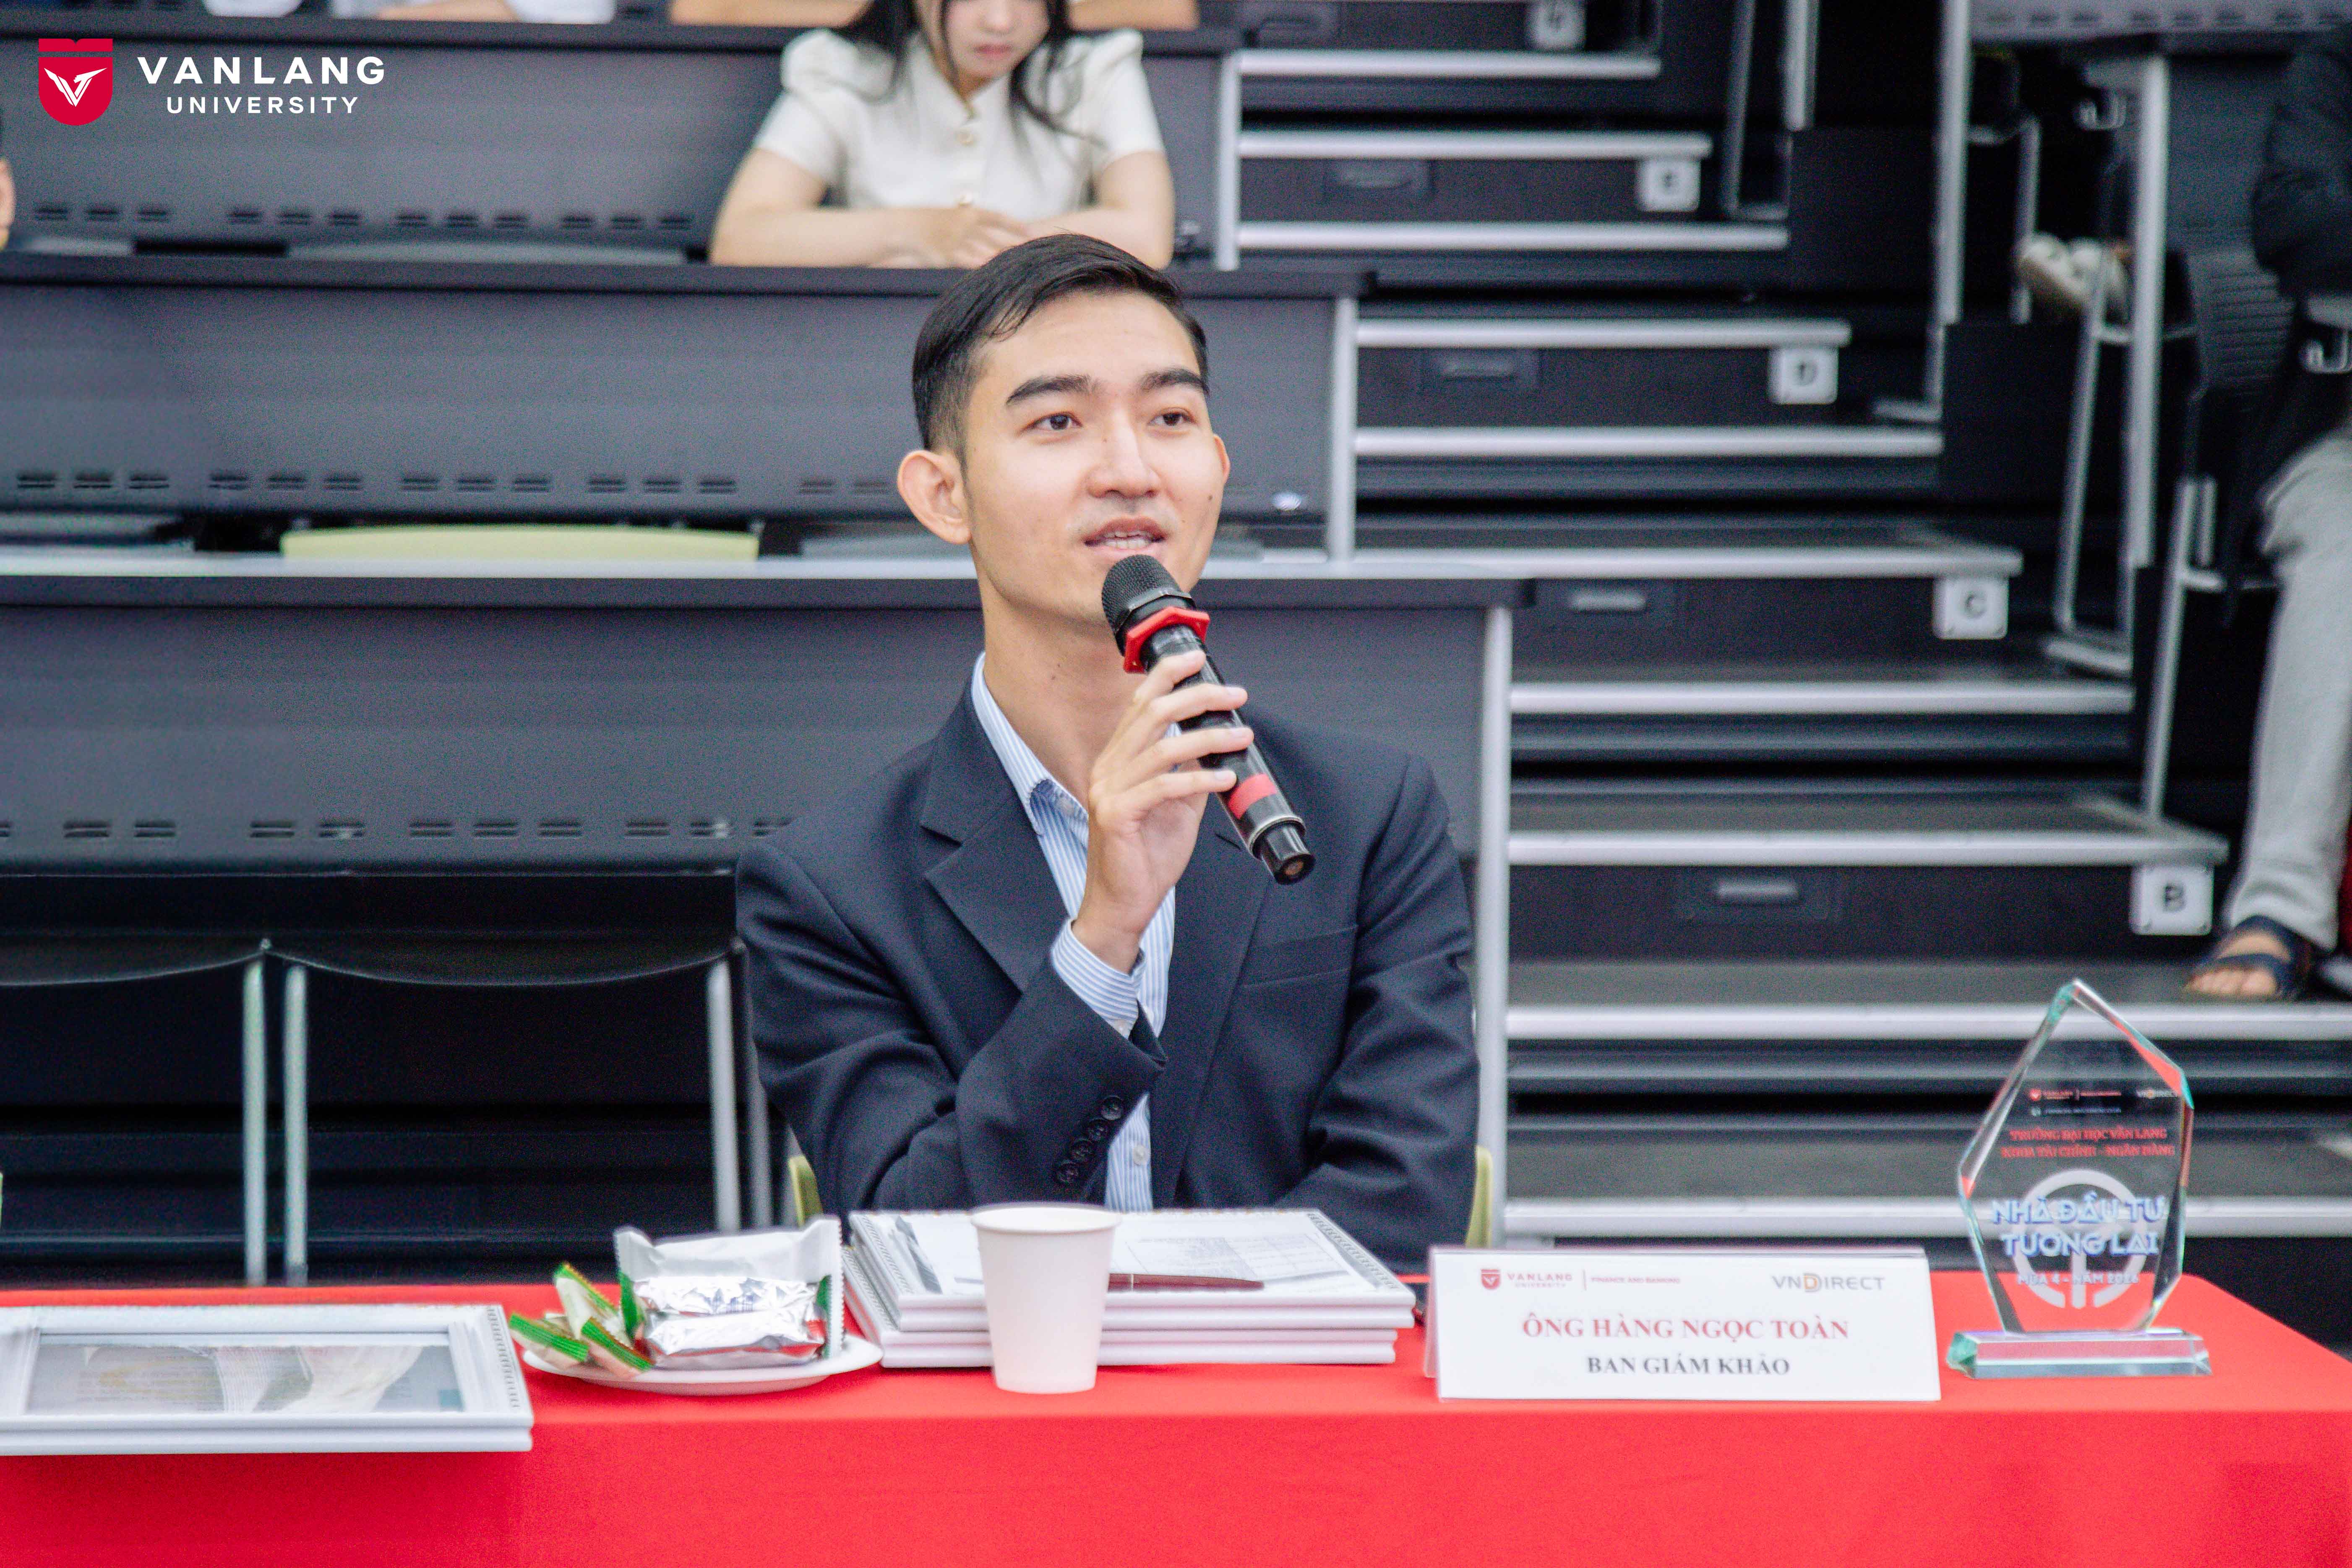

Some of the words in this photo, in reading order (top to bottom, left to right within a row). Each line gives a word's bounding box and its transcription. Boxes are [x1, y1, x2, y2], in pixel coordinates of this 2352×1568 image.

[1964, 592, 1986, 618] C
[2163, 883, 2185, 911] B
[1991, 1196, 2054, 1224] NHÀ
[2055, 1191, 2119, 1224] ĐẦU
[2109, 1231, 2159, 1256] LAI
[1507, 1273, 1573, 1281] VANLANG
[1771, 1272, 1885, 1293] VNDIRECT
[1522, 1312, 1584, 1338] ÔNG
[1593, 1313, 1673, 1338] HÀNG
[1681, 1319, 1763, 1343] NGỌC
[1770, 1315, 1849, 1339] TOÀN
[1587, 1356, 1636, 1374] BAN
[1643, 1353, 1710, 1375] GIÁM
[1717, 1352, 1790, 1375] KHẢO
